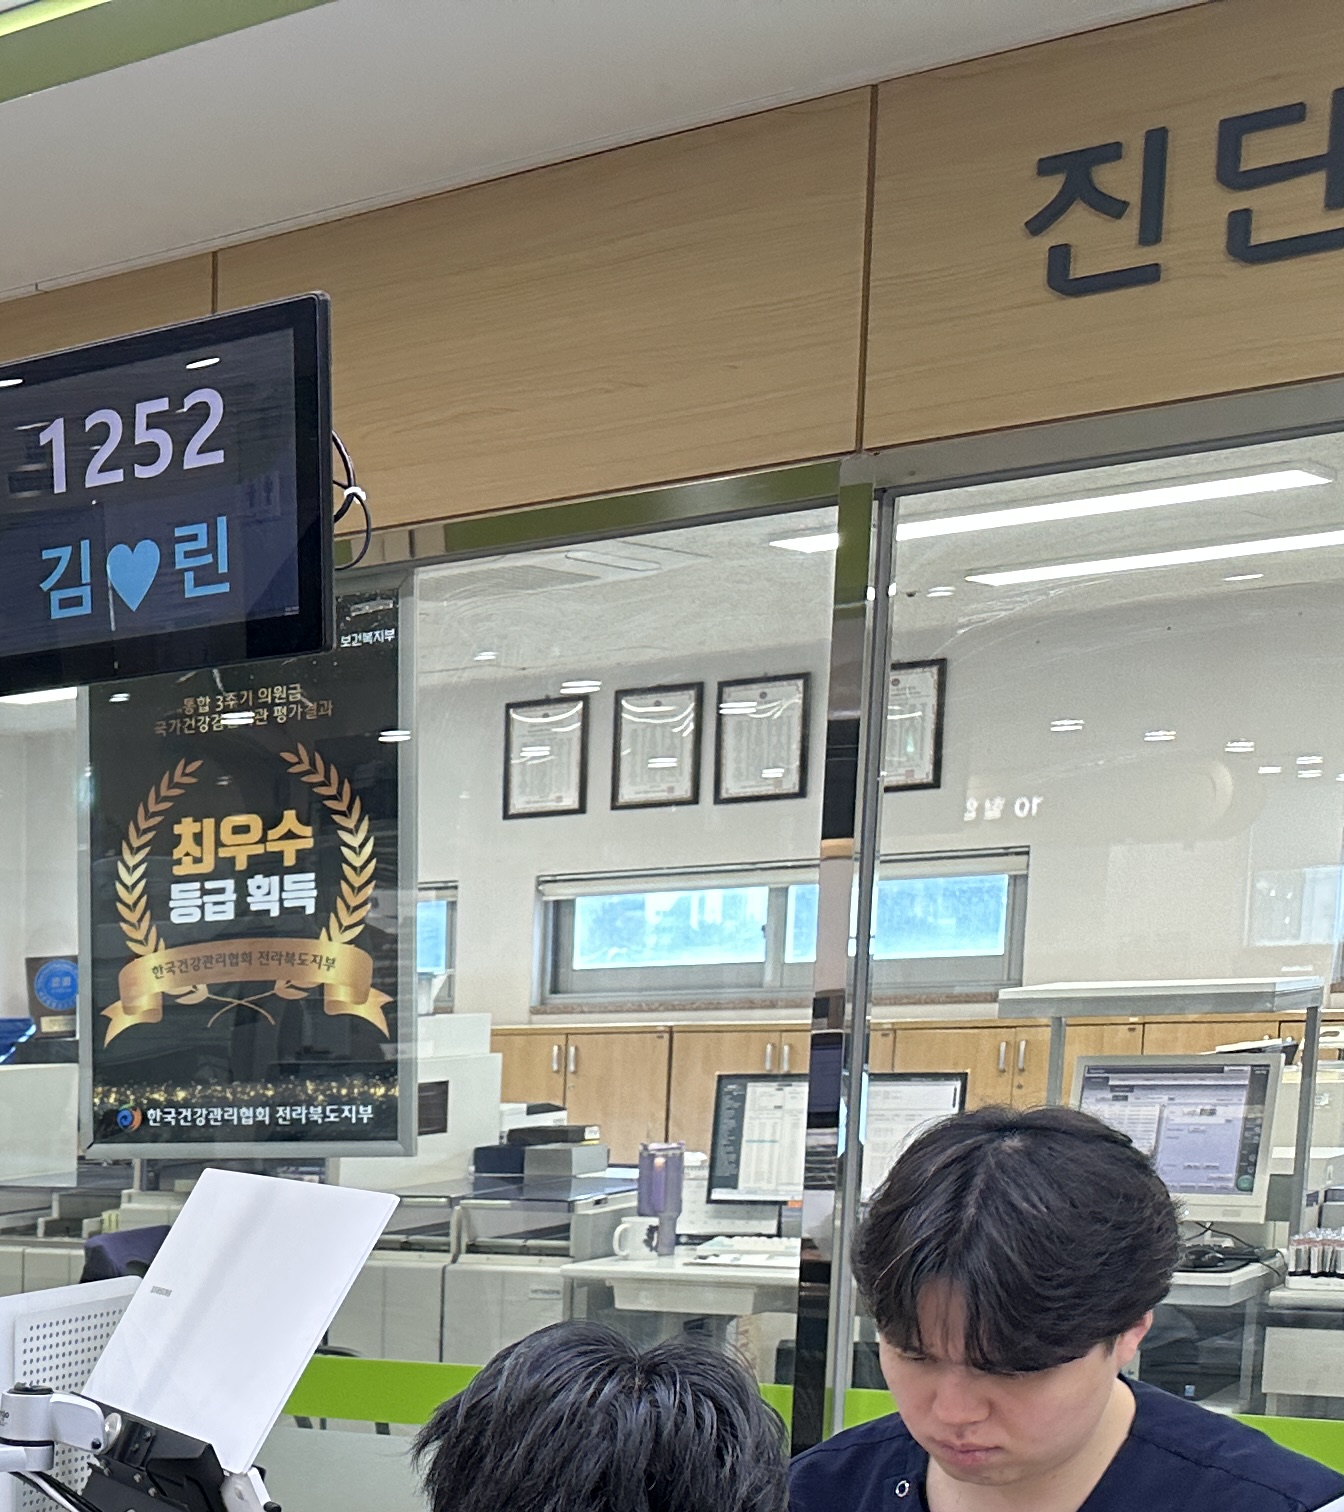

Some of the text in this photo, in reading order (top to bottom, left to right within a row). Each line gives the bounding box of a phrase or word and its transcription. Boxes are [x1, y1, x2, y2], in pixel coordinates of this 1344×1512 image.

[39, 388, 225, 494] 1252
[340, 628, 396, 648] 보건복지부
[183, 683, 303, 715] 통합 3주기 의원급
[154, 708, 269, 736] 국가건강검관
[172, 809, 314, 876] 최우수
[169, 872, 318, 924] 등급 획득
[151, 951, 337, 980] 한국건강관리협회 전라북도지부
[146, 1105, 374, 1127] 한국건강관리협회 전라북도지부
